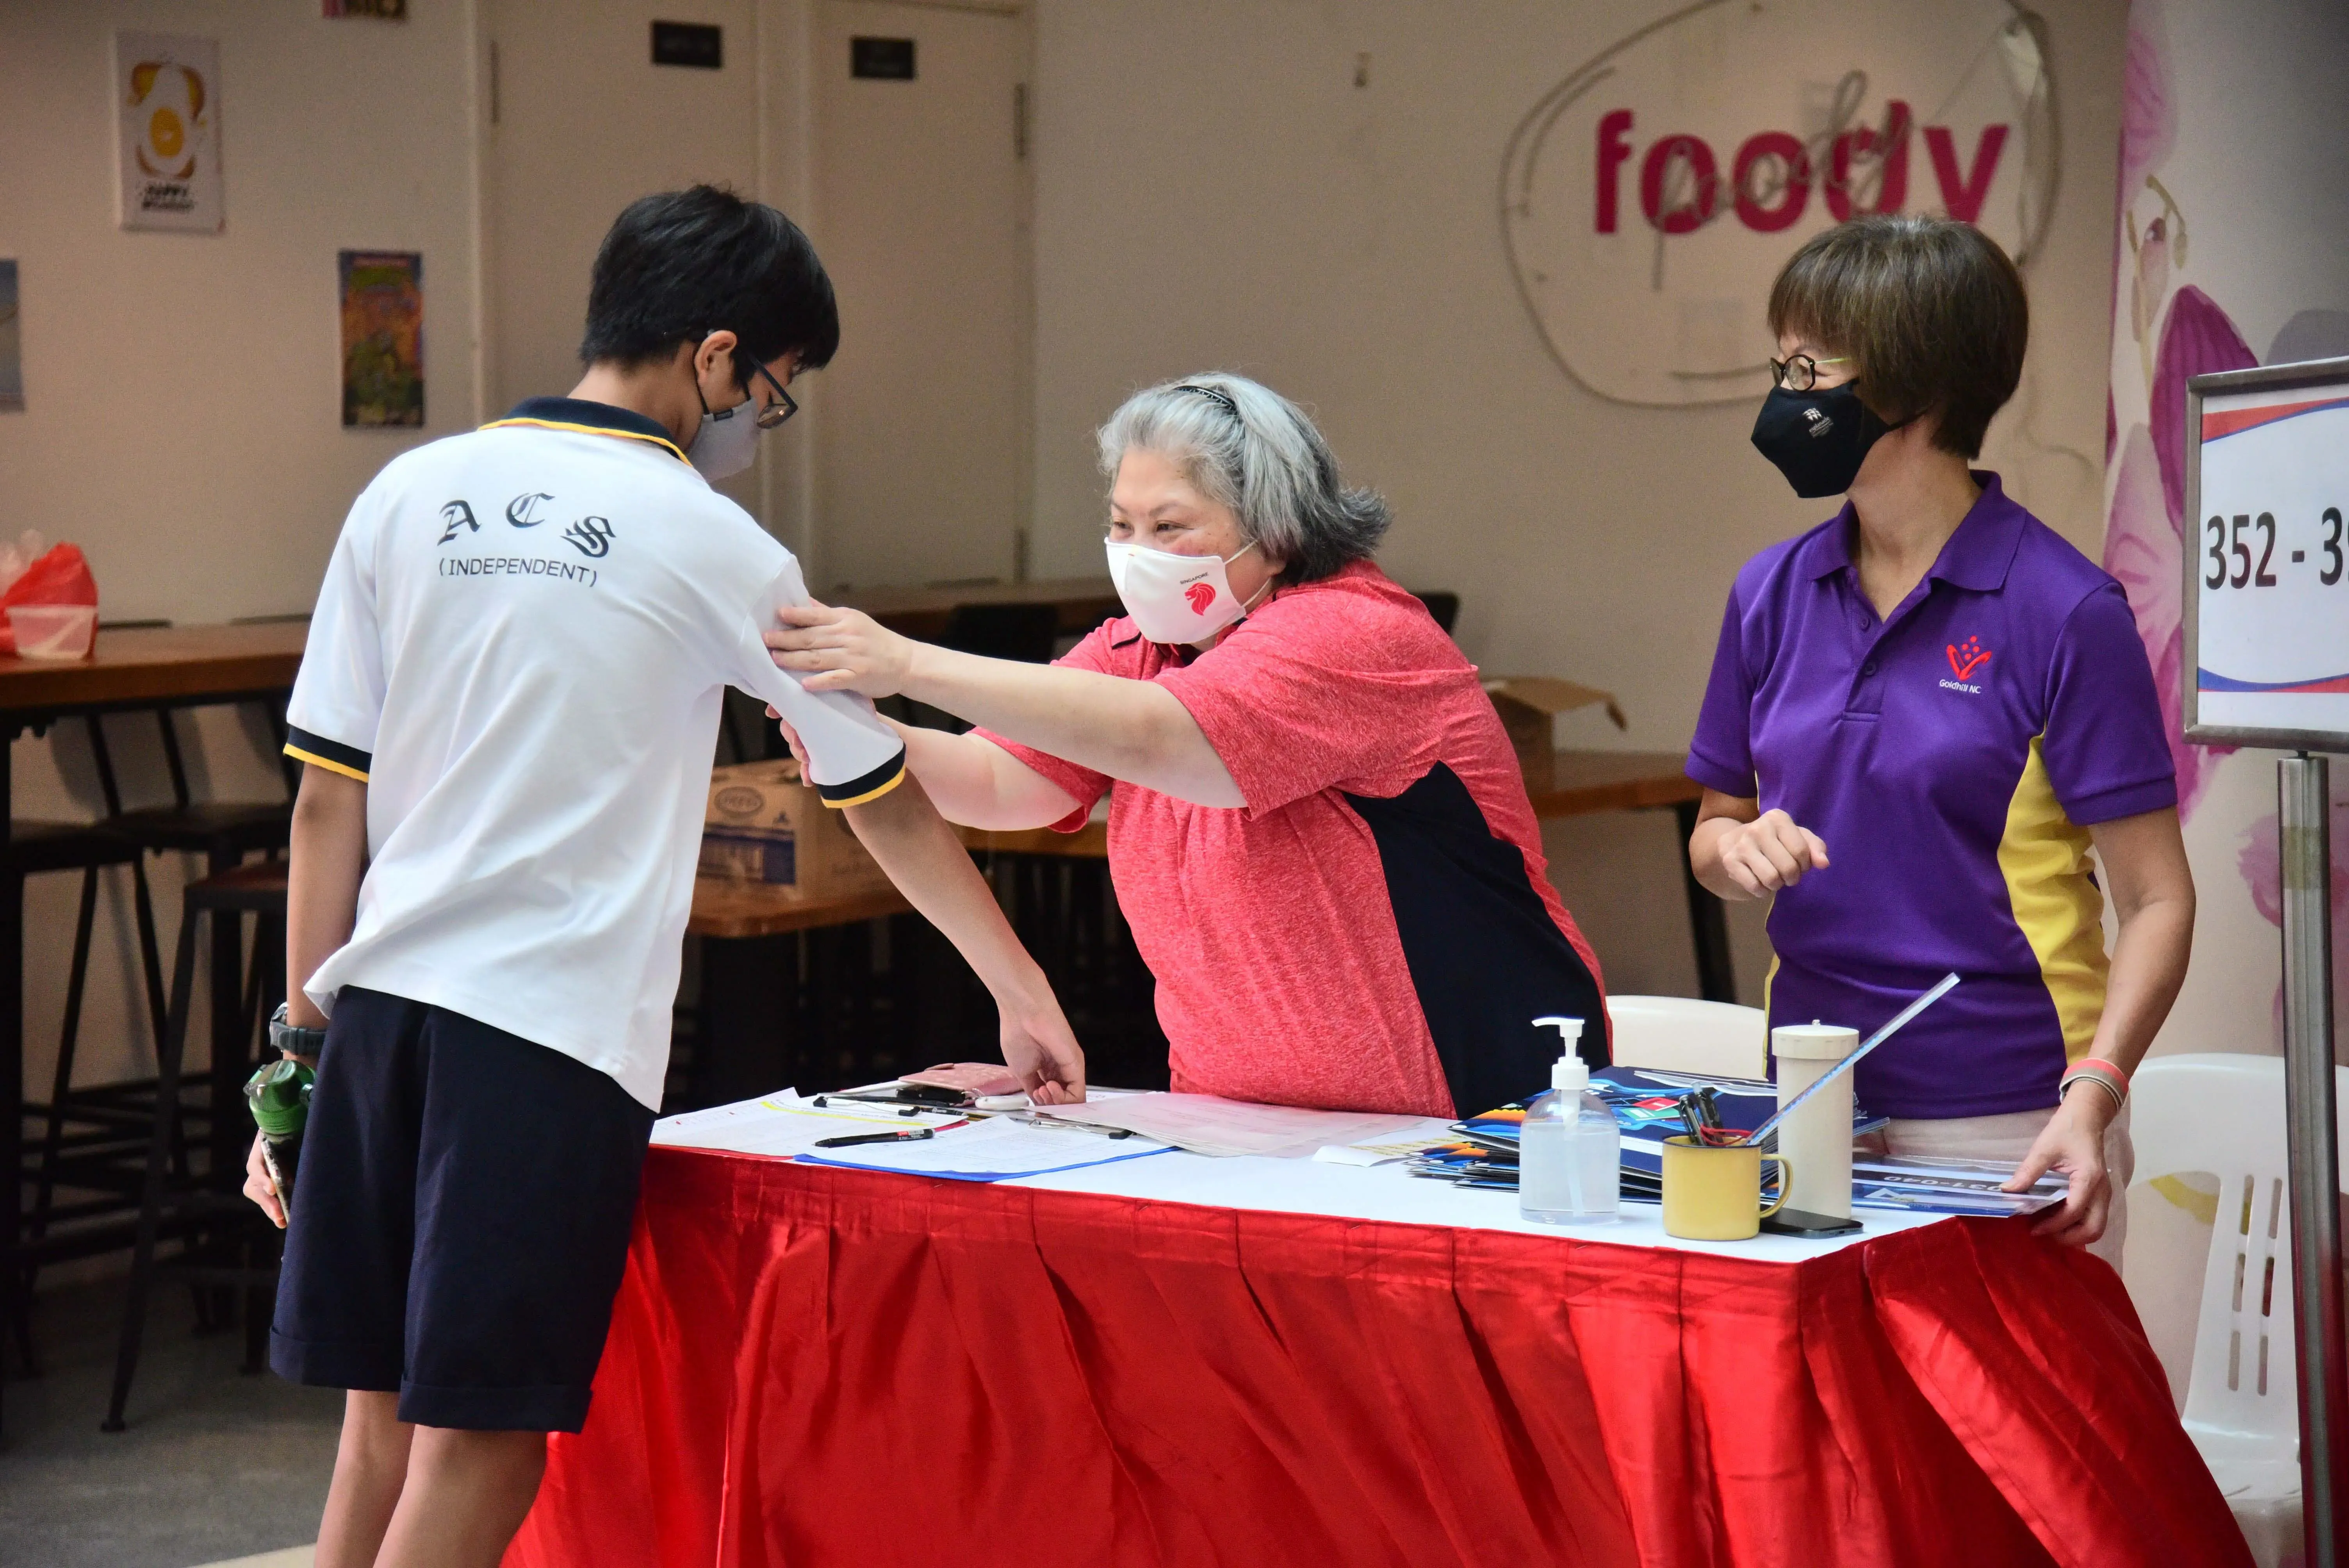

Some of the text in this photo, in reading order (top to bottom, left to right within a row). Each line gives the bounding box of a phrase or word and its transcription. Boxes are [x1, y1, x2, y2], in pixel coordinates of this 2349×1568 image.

[437, 493, 616, 558] A C S
[2206, 506, 2349, 590] 352 - 3
[439, 558, 597, 587] (INDEPENDENT)
[1180, 572, 1209, 584] SINGAPORE
[1939, 679, 1982, 694] Goldhill NC
